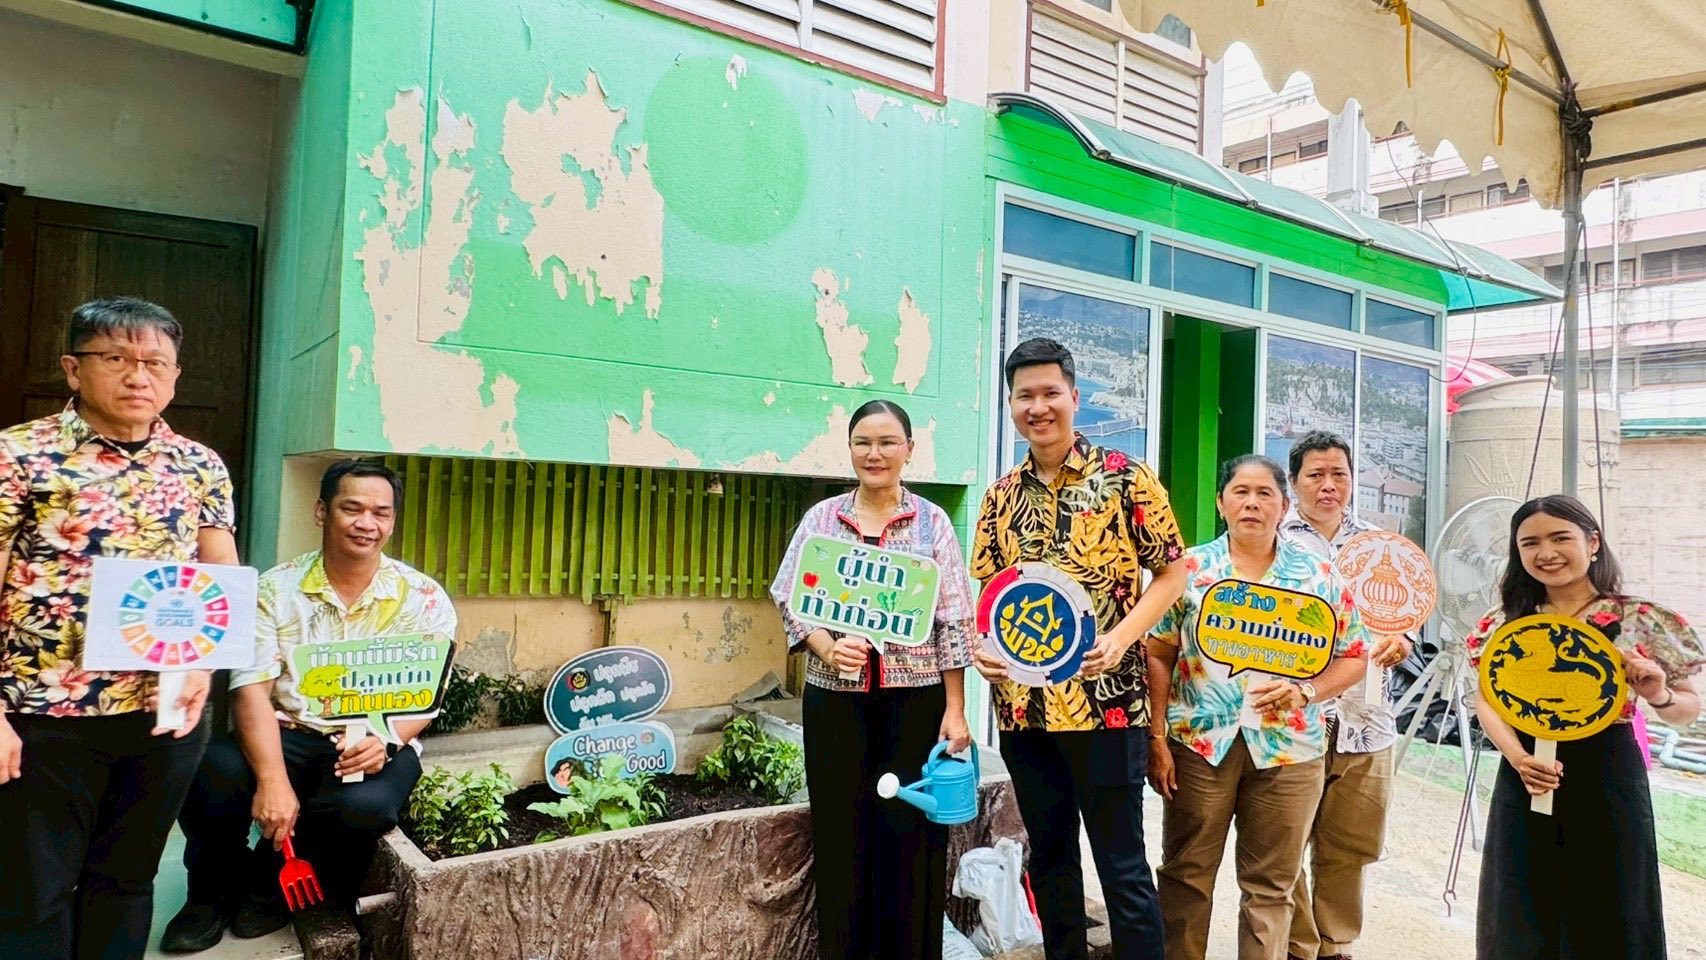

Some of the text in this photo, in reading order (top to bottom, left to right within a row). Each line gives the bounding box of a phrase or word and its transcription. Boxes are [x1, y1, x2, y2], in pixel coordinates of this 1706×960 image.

[836, 548, 906, 590] ผู้นำ
[1214, 582, 1277, 612] สร้าง
[800, 588, 915, 638] ทำก่อน
[1205, 614, 1328, 648] ความมั่นคง
[308, 638, 438, 667] บ้านนี้มีรัก
[1204, 635, 1298, 669] ทางอาหาร
[341, 666, 432, 693] ปลูกผัก
[339, 689, 433, 714] กินเอง
[573, 733, 637, 756] Change
[626, 749, 667, 773] Good
